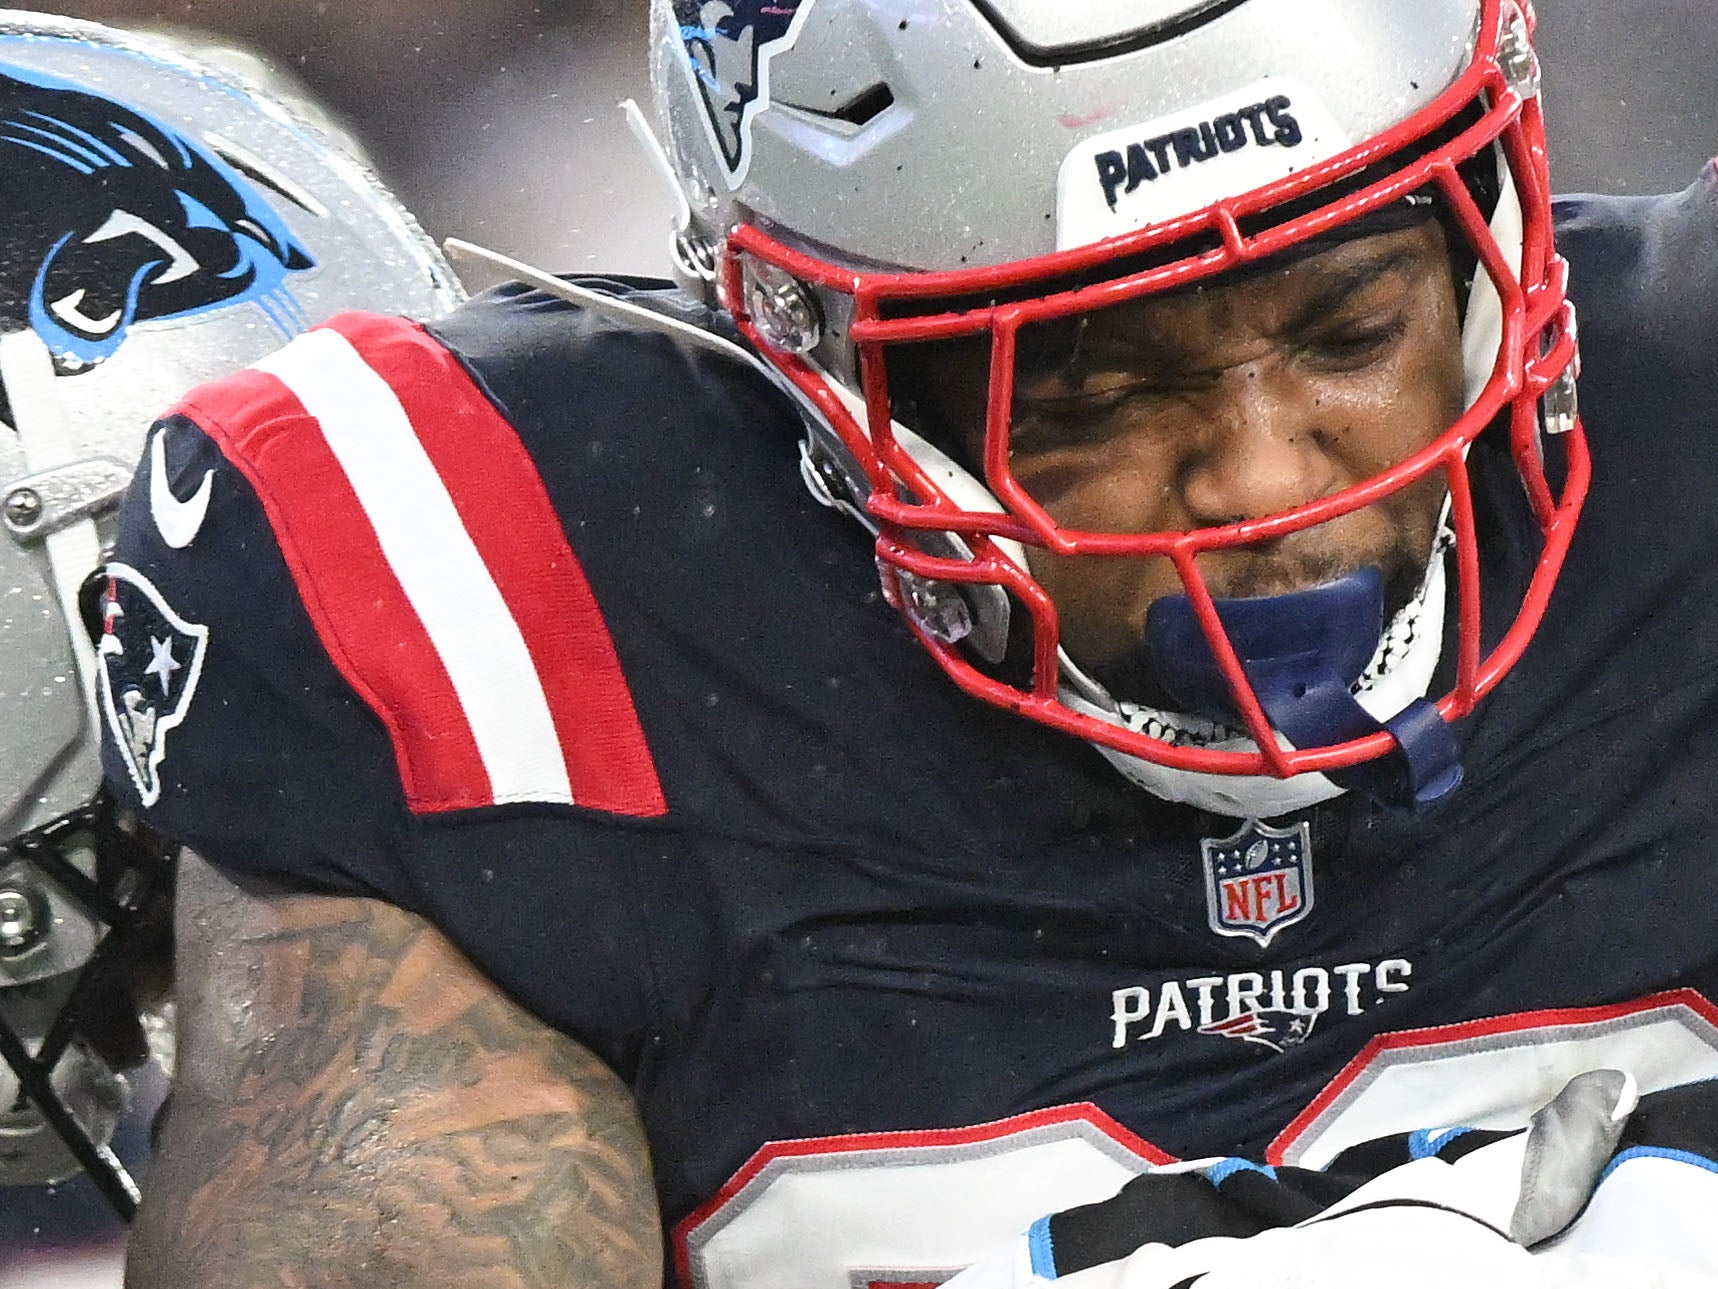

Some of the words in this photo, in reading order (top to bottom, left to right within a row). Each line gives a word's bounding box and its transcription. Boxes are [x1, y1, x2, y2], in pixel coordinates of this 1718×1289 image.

[1095, 95, 1302, 211] PATRIOTS
[1222, 873, 1298, 922] NFL
[1110, 958, 1412, 1049] PATRIOTS
